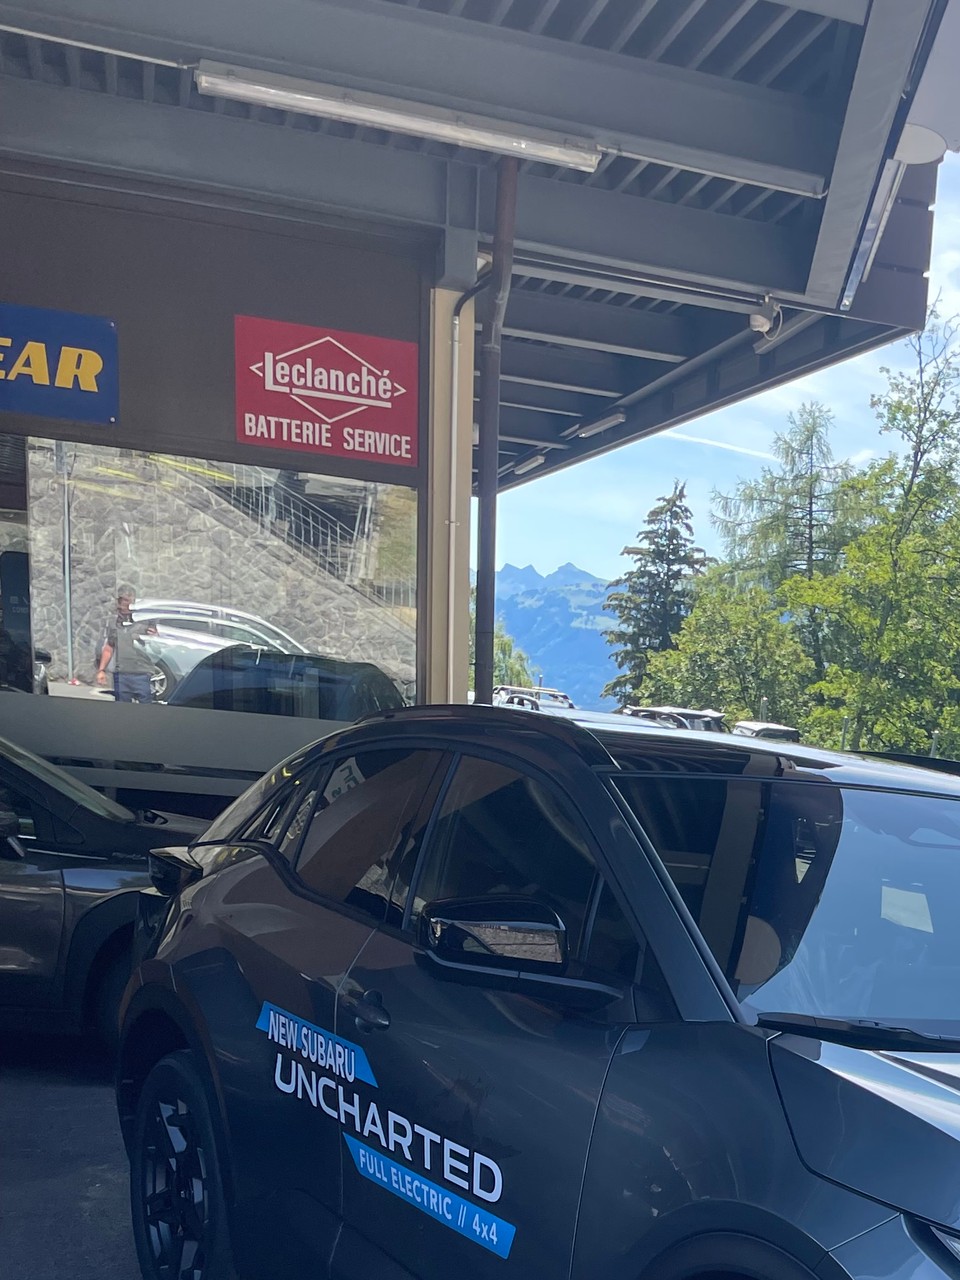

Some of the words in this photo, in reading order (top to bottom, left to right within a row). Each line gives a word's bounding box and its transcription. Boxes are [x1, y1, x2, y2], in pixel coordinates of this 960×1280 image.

[0, 337, 103, 392] AR
[264, 351, 393, 400] Leclanché
[244, 413, 332, 448] BATTERIE
[343, 427, 412, 459] SERVICE
[267, 1010, 299, 1052] NEW
[301, 1026, 355, 1083] SUBARU
[274, 1052, 503, 1203] UNCHARTED
[358, 1147, 388, 1184] FULL
[391, 1166, 453, 1221] ELECTRIC
[472, 1213, 498, 1245] 4x4
